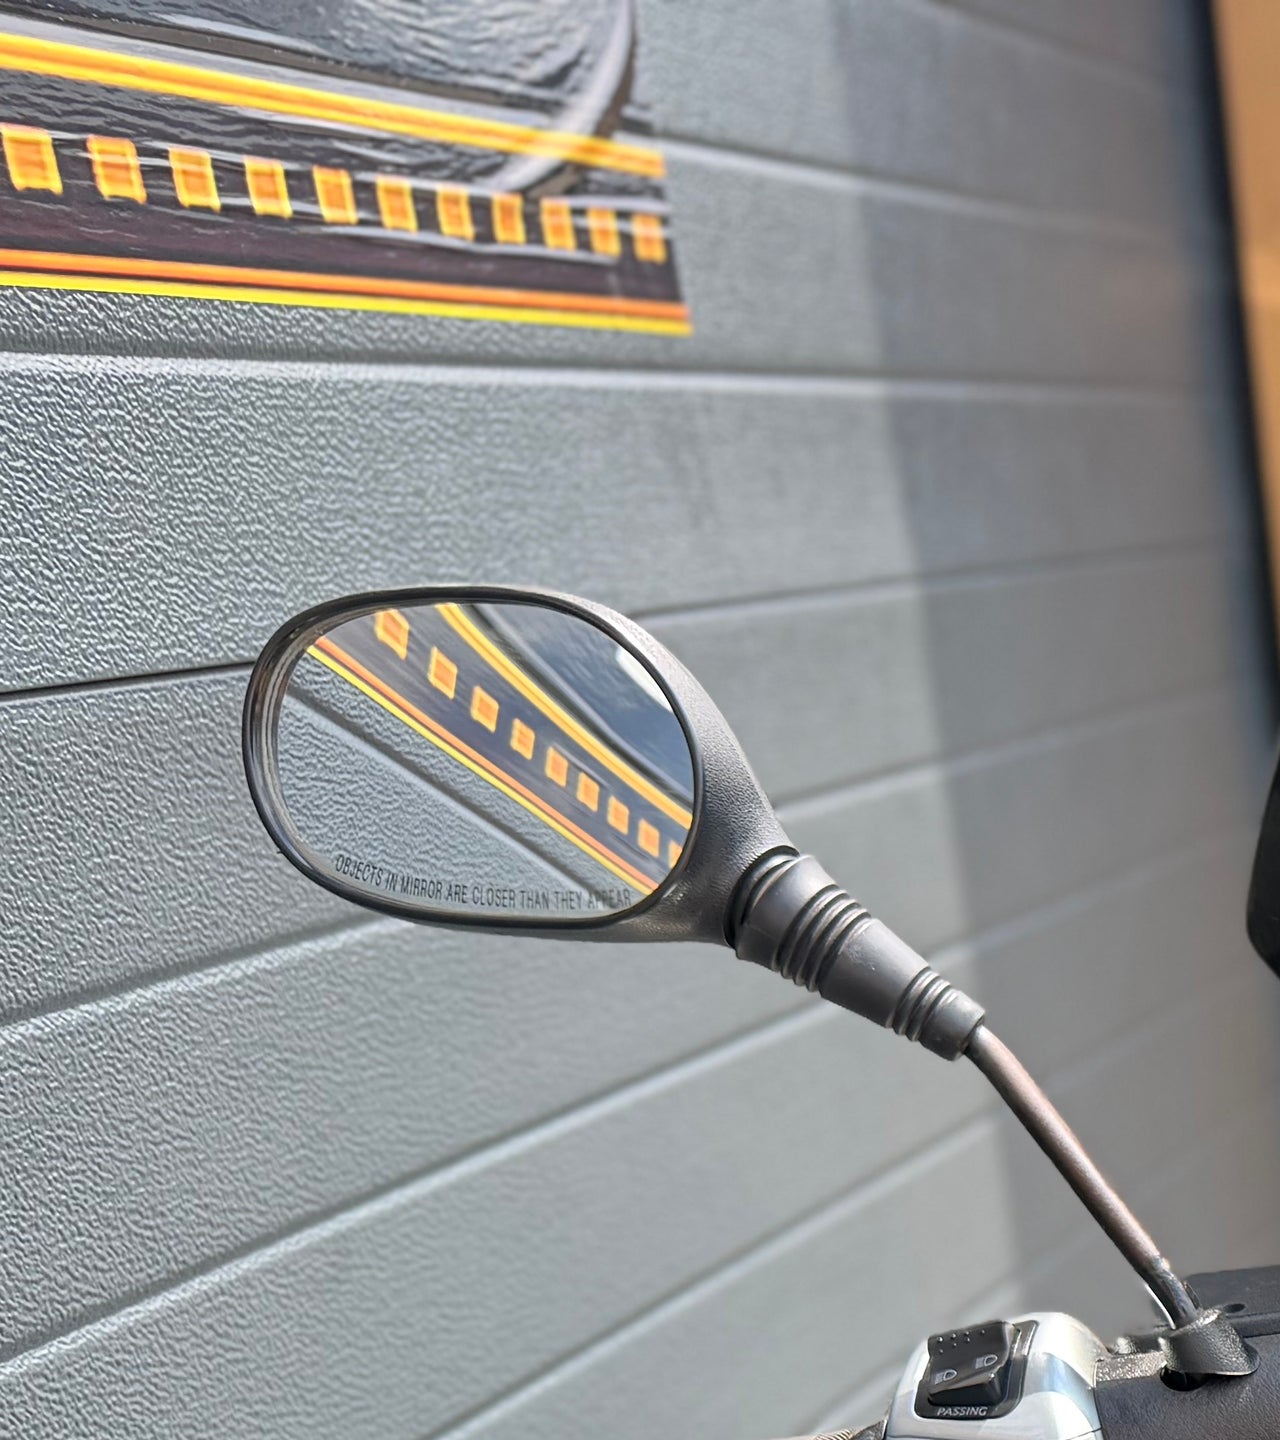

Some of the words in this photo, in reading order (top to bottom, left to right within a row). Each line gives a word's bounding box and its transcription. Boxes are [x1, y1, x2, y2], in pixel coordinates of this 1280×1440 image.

[335, 854, 382, 886] OBJECTS
[385, 871, 398, 892] IN
[400, 875, 443, 901] MIRROR
[446, 884, 467, 905] ARE
[472, 886, 516, 908] CLOSER
[519, 889, 550, 909] THAN
[553, 891, 584, 910] THEY
[937, 1406, 988, 1416] PASSING
